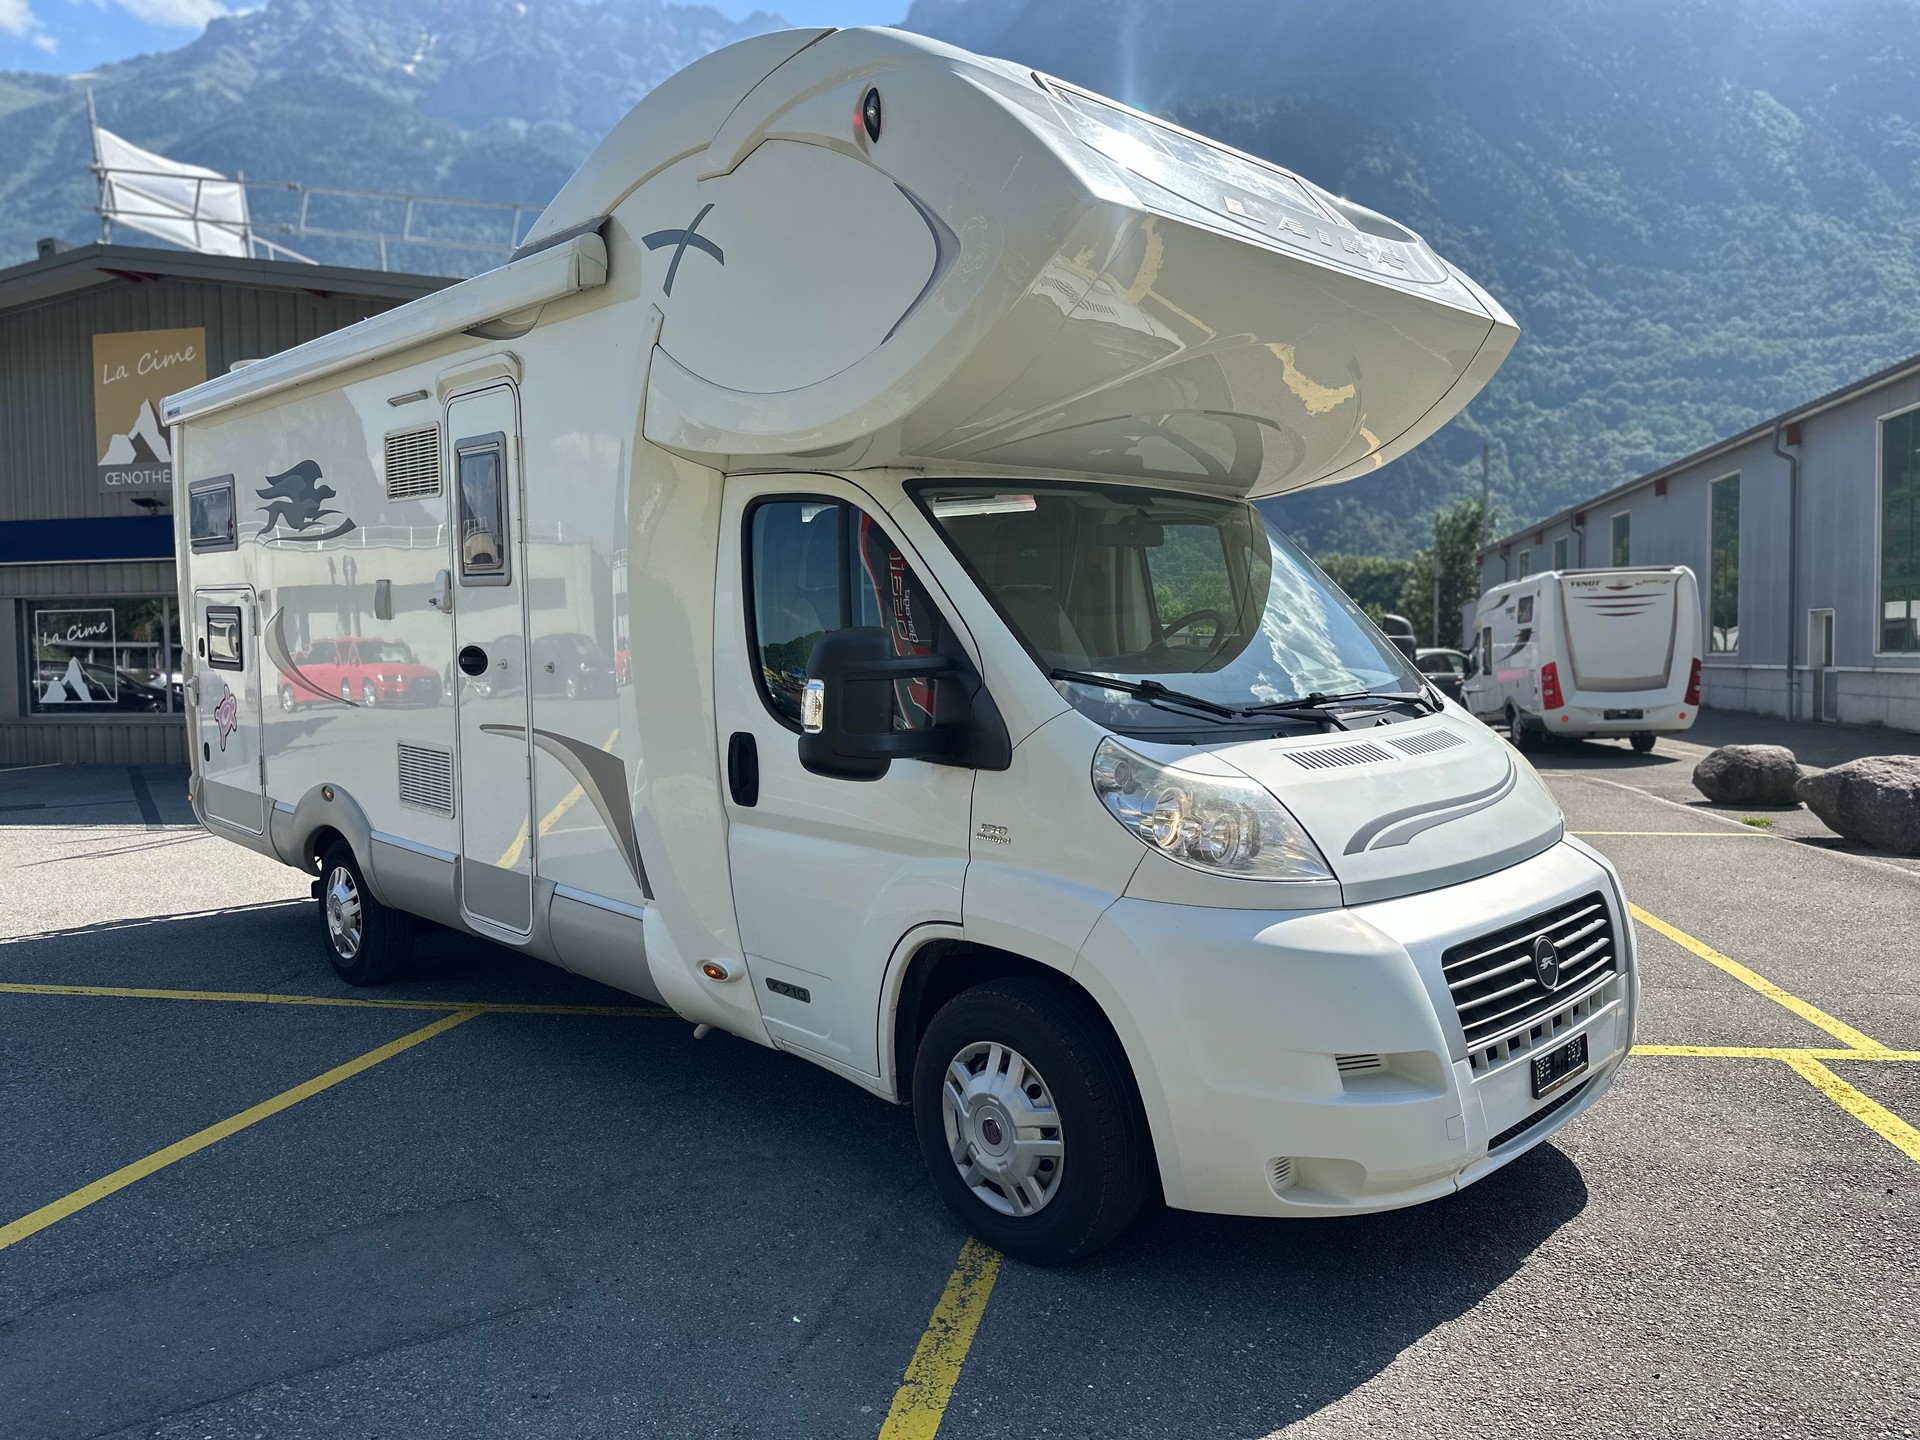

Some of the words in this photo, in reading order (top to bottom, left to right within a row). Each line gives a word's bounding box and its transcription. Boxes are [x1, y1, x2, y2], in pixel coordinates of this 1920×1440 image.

[103, 363, 129, 385] La
[137, 346, 198, 375] Cime
[43, 631, 61, 647] La
[66, 621, 108, 641] Cime
